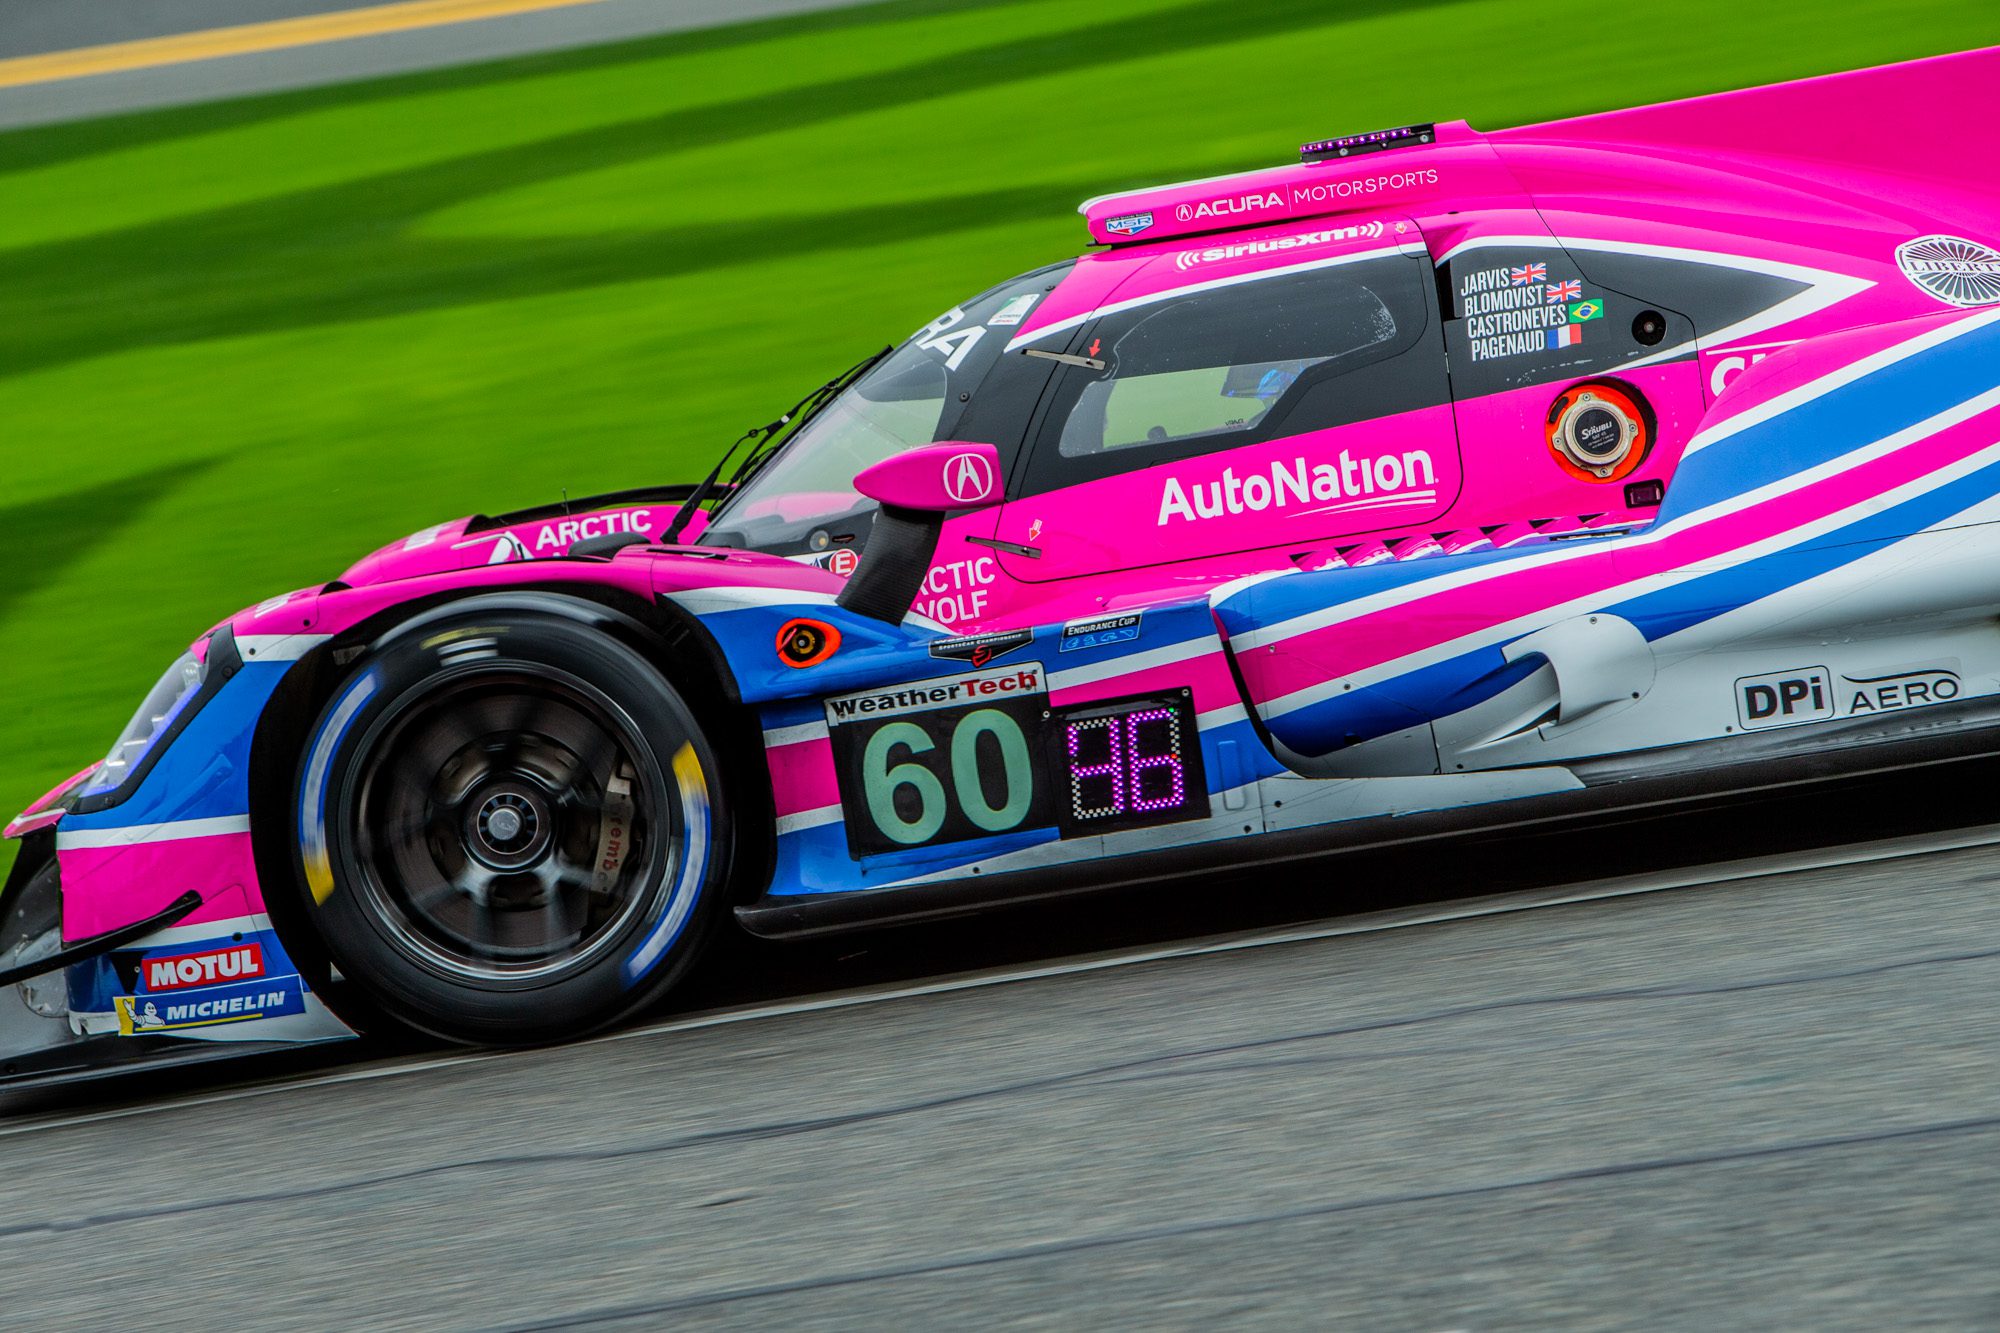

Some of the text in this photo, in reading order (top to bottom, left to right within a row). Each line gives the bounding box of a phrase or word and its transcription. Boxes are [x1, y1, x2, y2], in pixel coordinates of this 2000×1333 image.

[1194, 169, 1438, 219] ACURA MOTORSPORTS
[1108, 217, 1151, 230] MSR
[1461, 268, 1509, 296] JARVIS
[1909, 261, 2000, 272] LIBERT
[1464, 285, 1544, 317] BLOMQVIST
[1467, 304, 1566, 339] CASTRONEVES
[1471, 330, 1545, 362] PAGENAUD
[1157, 448, 1435, 526] AutoNation
[536, 510, 652, 550] ARCTIC
[920, 557, 996, 596] CTIC
[830, 670, 1038, 717] WeatherTech
[1744, 676, 1825, 720] DPi
[1849, 678, 1959, 714] AERO
[862, 708, 1034, 845] 60
[1067, 708, 1184, 811] 46
[151, 949, 259, 987] MOTUL
[166, 990, 286, 1021] MICHELIN
